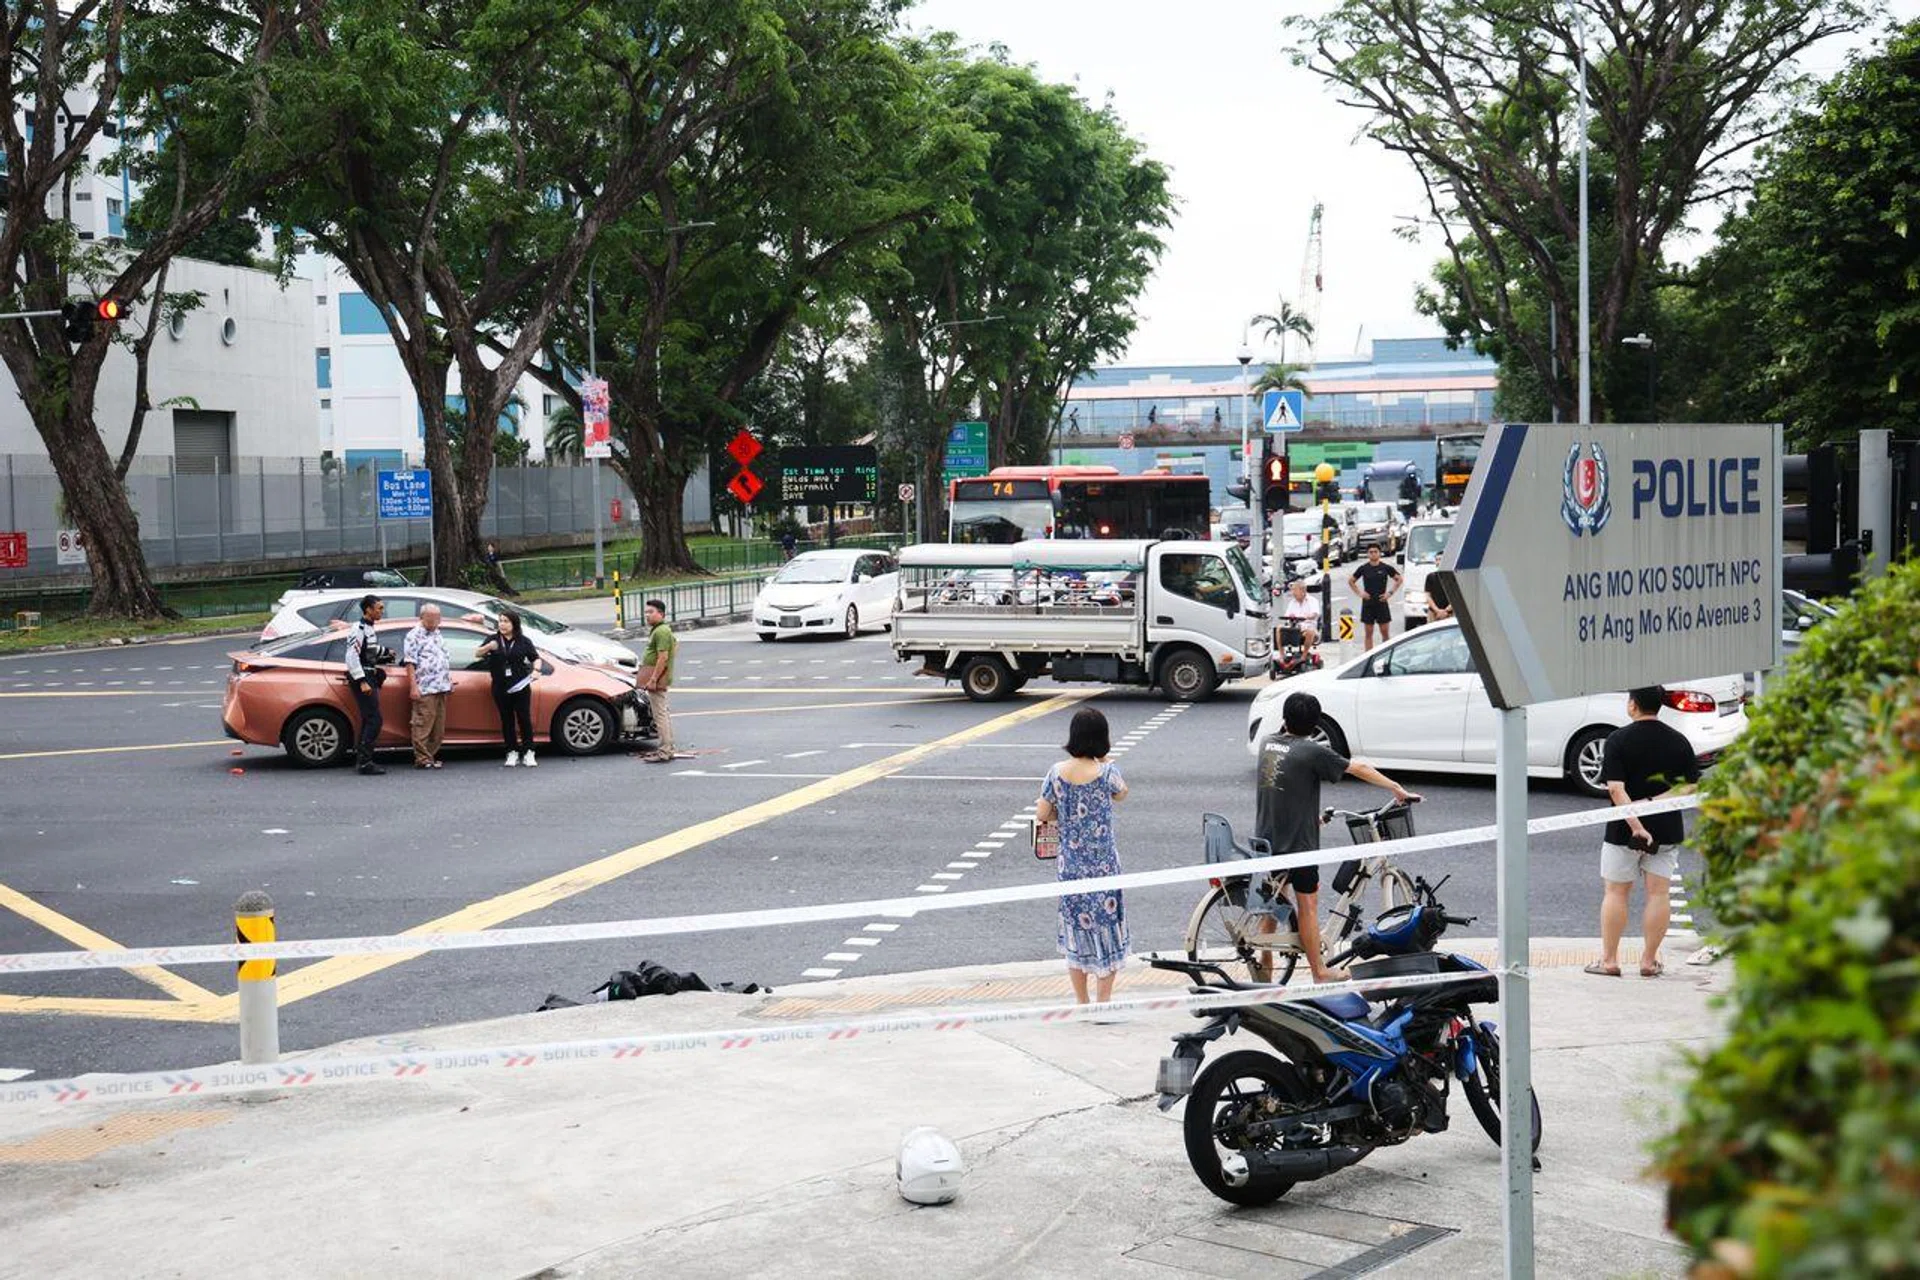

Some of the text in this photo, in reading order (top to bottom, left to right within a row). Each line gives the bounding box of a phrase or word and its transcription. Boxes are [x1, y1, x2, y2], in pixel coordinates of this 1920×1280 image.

[855, 466, 876, 474] Mins
[383, 480, 426, 490] Bus Lane
[788, 483, 835, 491] Cairnhill
[992, 482, 1015, 496] 74
[1632, 457, 1761, 520] POLICE
[788, 492, 804, 500] AYE
[1563, 558, 1761, 602] ANG MO KIO SOUTH NPC
[1578, 597, 1762, 644] 81 Ang Mo Kio Avenue 3
